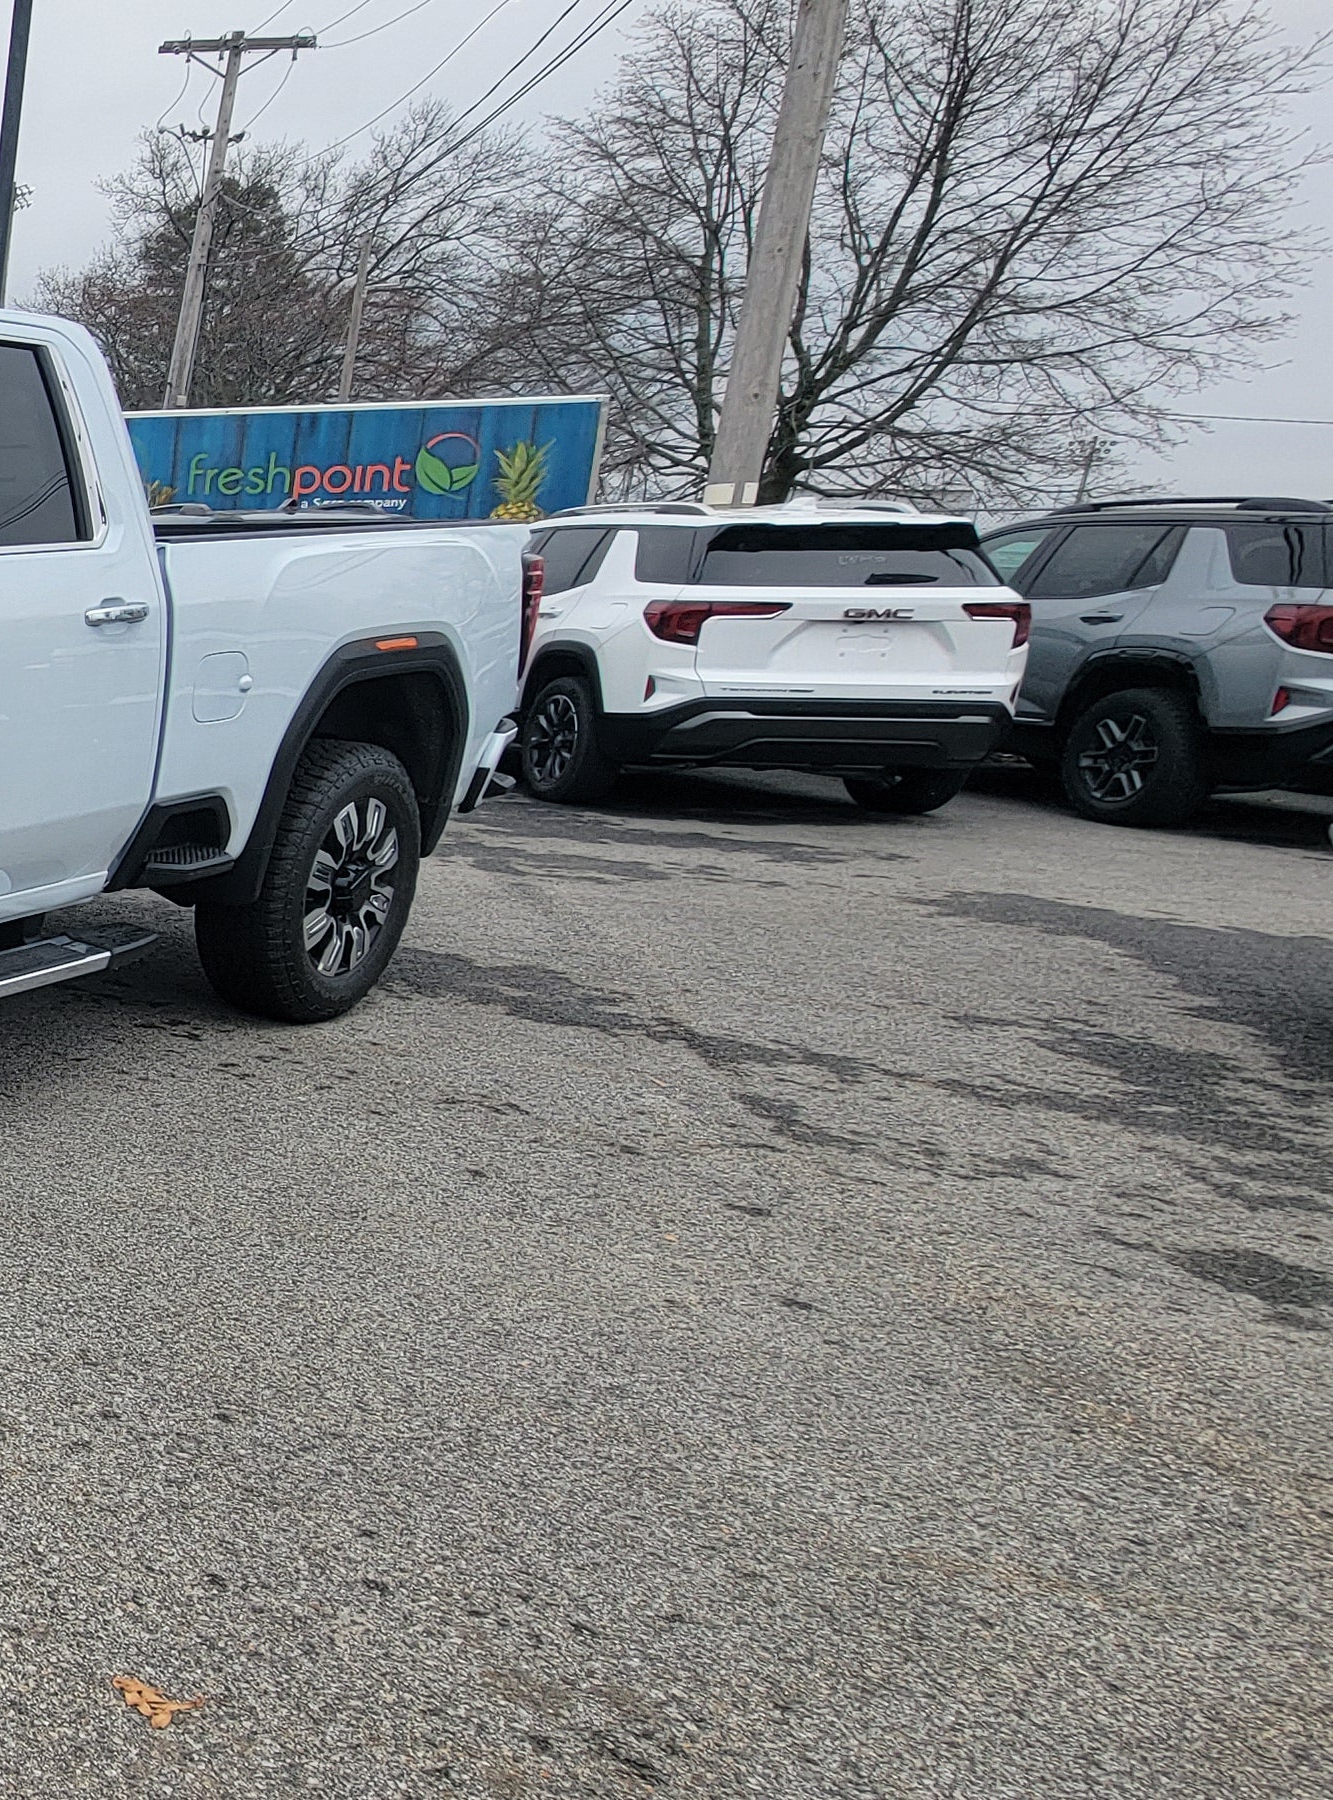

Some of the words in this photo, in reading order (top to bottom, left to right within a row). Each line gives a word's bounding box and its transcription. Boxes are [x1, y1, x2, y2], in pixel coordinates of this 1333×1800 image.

[187, 451, 412, 501] freshpoint
[300, 500, 310, 509] a
[843, 608, 915, 619] GMC
